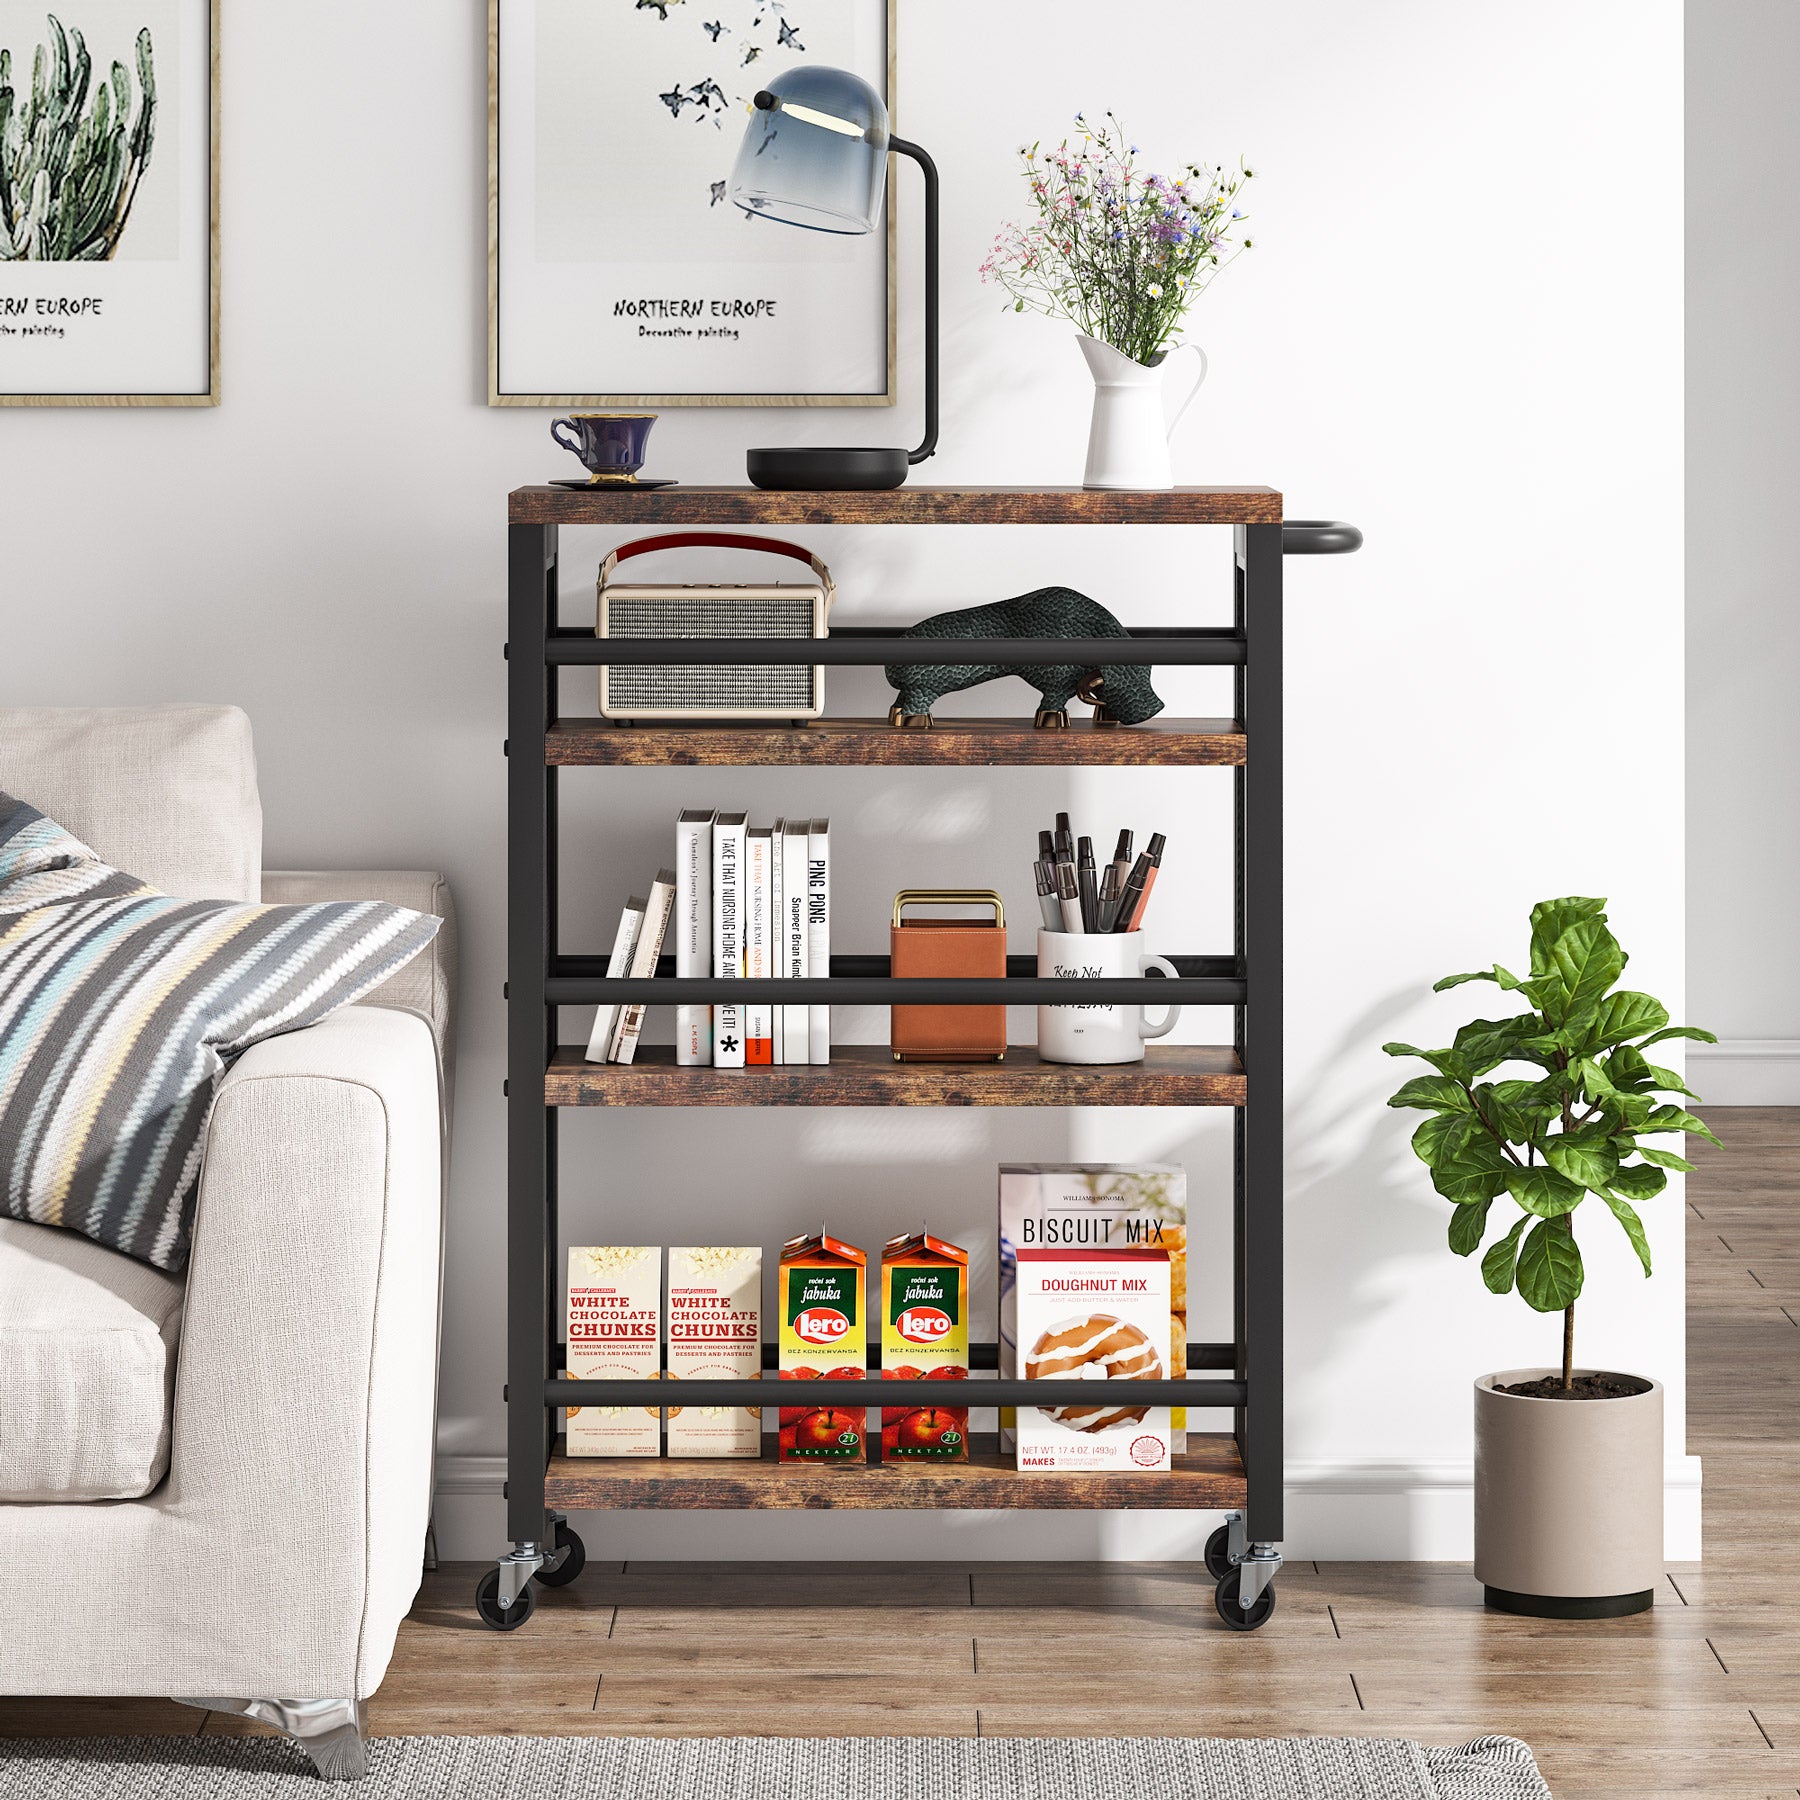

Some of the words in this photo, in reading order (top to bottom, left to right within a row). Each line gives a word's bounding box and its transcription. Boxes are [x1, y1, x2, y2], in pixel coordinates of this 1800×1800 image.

[36, 297, 103, 316] EUROPE
[613, 299, 704, 318] NORTHERN
[710, 299, 777, 318] EUROPE
[638, 325, 693, 337] Decorative
[722, 837, 736, 859] TAKE
[754, 843, 762, 862] TAKE
[722, 863, 736, 886] THAT
[754, 865, 762, 884] THAT
[809, 860, 826, 887] PING
[689, 875, 698, 897] Journey
[689, 900, 698, 923] Through
[722, 888, 736, 930] NURSING
[754, 886, 762, 921] NURSING
[809, 893, 826, 924] PONG
[791, 897, 802, 931] Snapper
[754, 923, 762, 946] HOME
[722, 933, 736, 959] HOME
[791, 934, 802, 956] Brian
[754, 948, 762, 965] AND
[1023, 1218, 1113, 1243] BISCUIT
[1126, 1218, 1164, 1243] MIX
[800, 1285, 841, 1304] jabuka
[902, 1284, 944, 1303] jabuka
[1041, 1278, 1118, 1292] DOUGHNUT
[1122, 1278, 1147, 1292] MIX
[570, 1297, 630, 1307] WHITE
[671, 1297, 731, 1308] WHITE
[569, 1311, 656, 1320] CHOCOLATE
[671, 1311, 757, 1320] CHOCOLATE
[569, 1323, 656, 1336] CHUNKS
[670, 1323, 757, 1336] CHUNKS
[1022, 1446, 1038, 1454] NET
[1092, 1446, 1117, 1456] (493g)
[1022, 1457, 1055, 1466] MAKES
